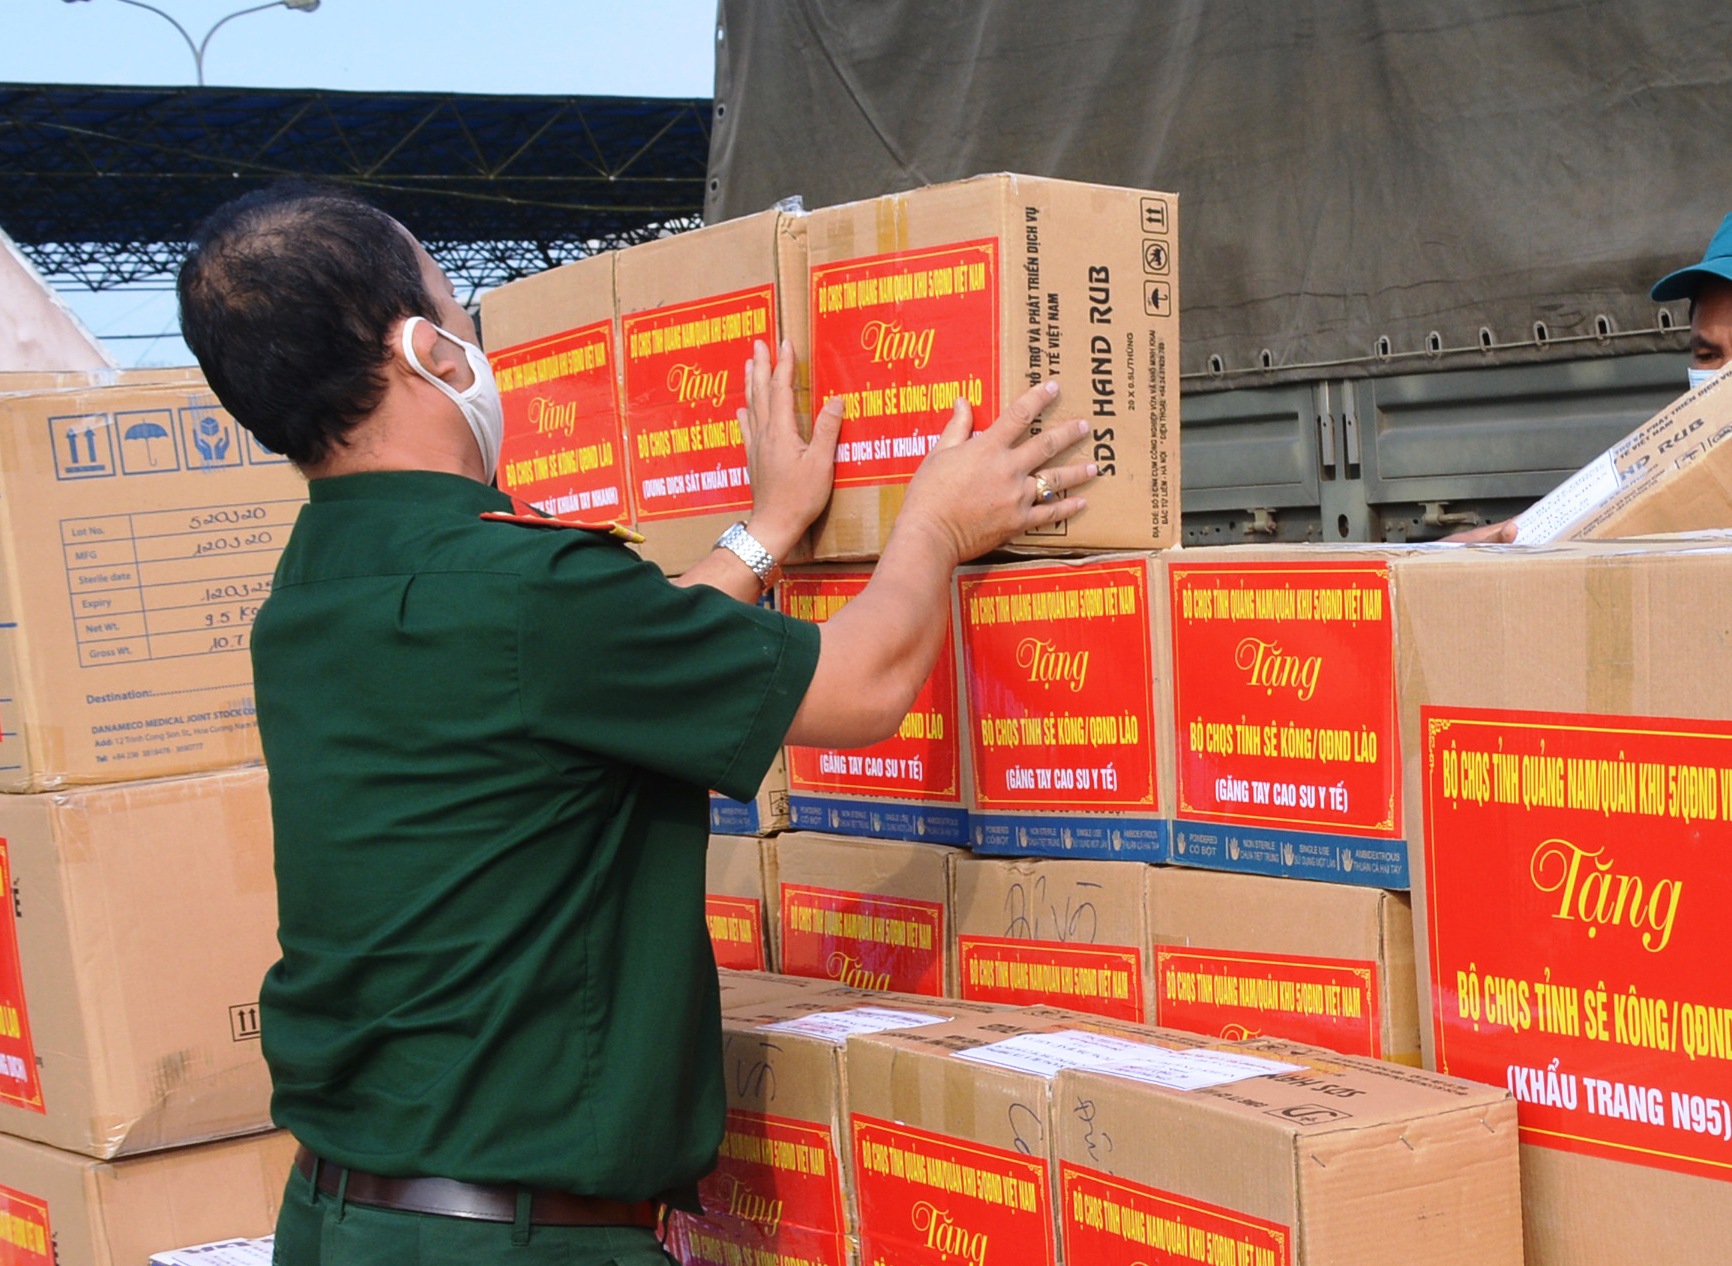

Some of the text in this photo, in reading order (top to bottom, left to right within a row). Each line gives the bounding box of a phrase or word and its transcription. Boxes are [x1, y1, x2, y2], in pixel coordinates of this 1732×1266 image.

[1022, 207, 1044, 368] TRỢ VÀ PHÁT TRIỂN DỊCH VỤ
[1047, 294, 1063, 376] Y TẾ VIỆT NAM
[1087, 265, 1116, 476] SDS HAND RUB
[1127, 400, 1135, 411] 20
[75, 551, 97, 560] MFG
[112, 572, 131, 581] date
[83, 599, 111, 608] Expiry
[86, 624, 101, 633] Net
[90, 649, 112, 659] Gross
[92, 708, 242, 734] DANAMECO MEDICAL JOINT STOCK
[1215, 775, 1349, 813] (GĂNG TAY CAO SU Y TẾ)
[1529, 838, 1683, 952] Tặng
[1457, 962, 1481, 1032] BỘ
[1484, 975, 1531, 1034] CHQS
[1534, 967, 1580, 1037] TỈNH
[1583, 980, 1610, 1042] SÊ
[1507, 1057, 1732, 1142] (KHẨU TRANG N95)
